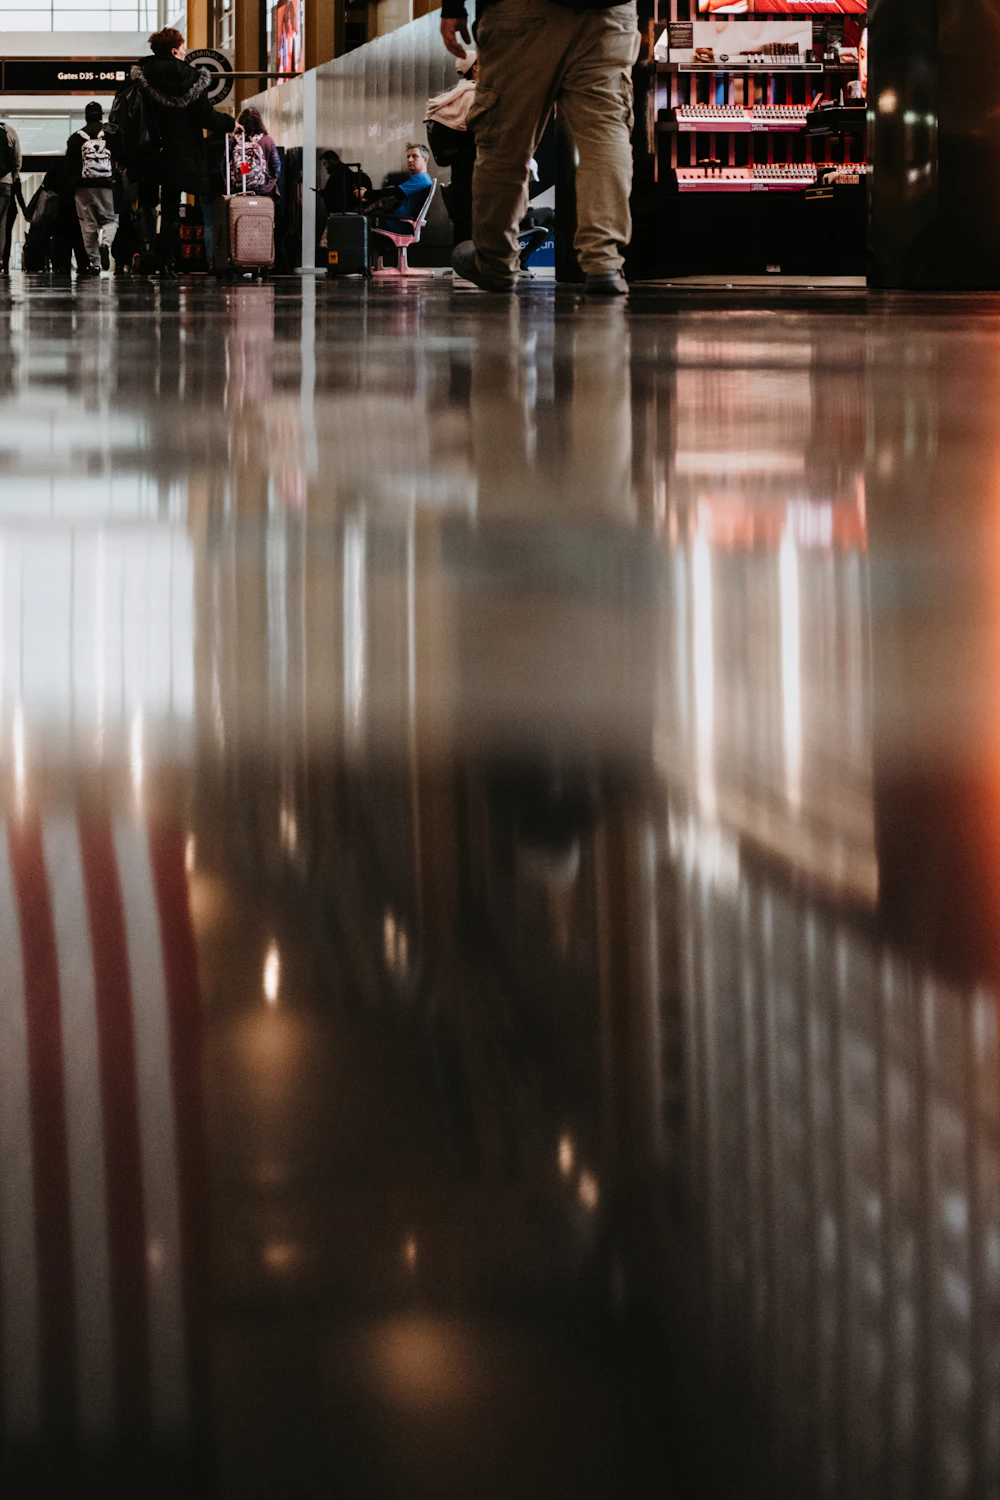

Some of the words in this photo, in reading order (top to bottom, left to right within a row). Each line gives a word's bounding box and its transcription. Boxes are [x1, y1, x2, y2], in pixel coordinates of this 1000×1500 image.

[57, 72, 78, 80] Gates
[79, 72, 94, 80] D35
[100, 72, 115, 80] D45
